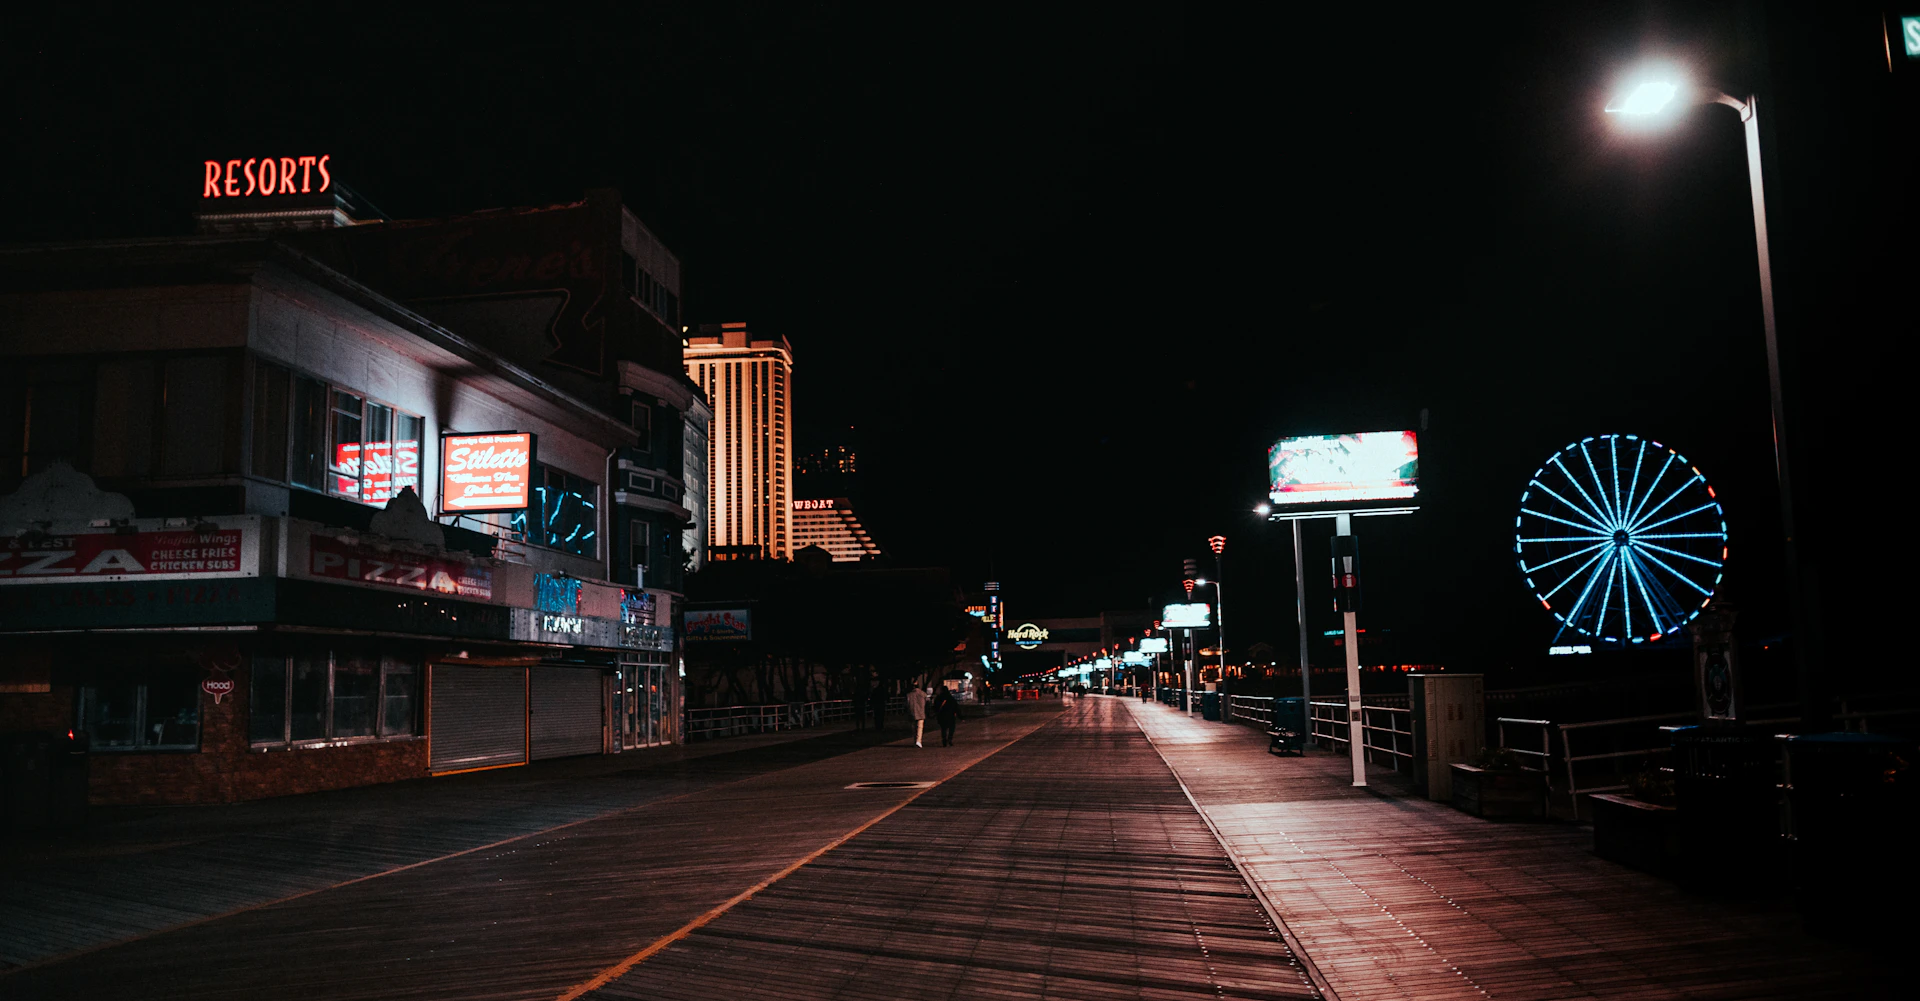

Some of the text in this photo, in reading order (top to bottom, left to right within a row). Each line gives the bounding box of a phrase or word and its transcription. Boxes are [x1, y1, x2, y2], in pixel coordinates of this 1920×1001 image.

[203, 154, 330, 198] RESORTS
[446, 446, 528, 472] Stiletto
[199, 533, 237, 545] Wings
[152, 547, 236, 560] CHEESE FRIES
[0, 549, 147, 576] ZA
[150, 559, 236, 571] CHICKEN SUBS
[313, 551, 458, 594] PIZZA
[686, 612, 747, 634] Bright Star
[1007, 628, 1049, 640] Hard Rock
[207, 680, 231, 690] Hood
